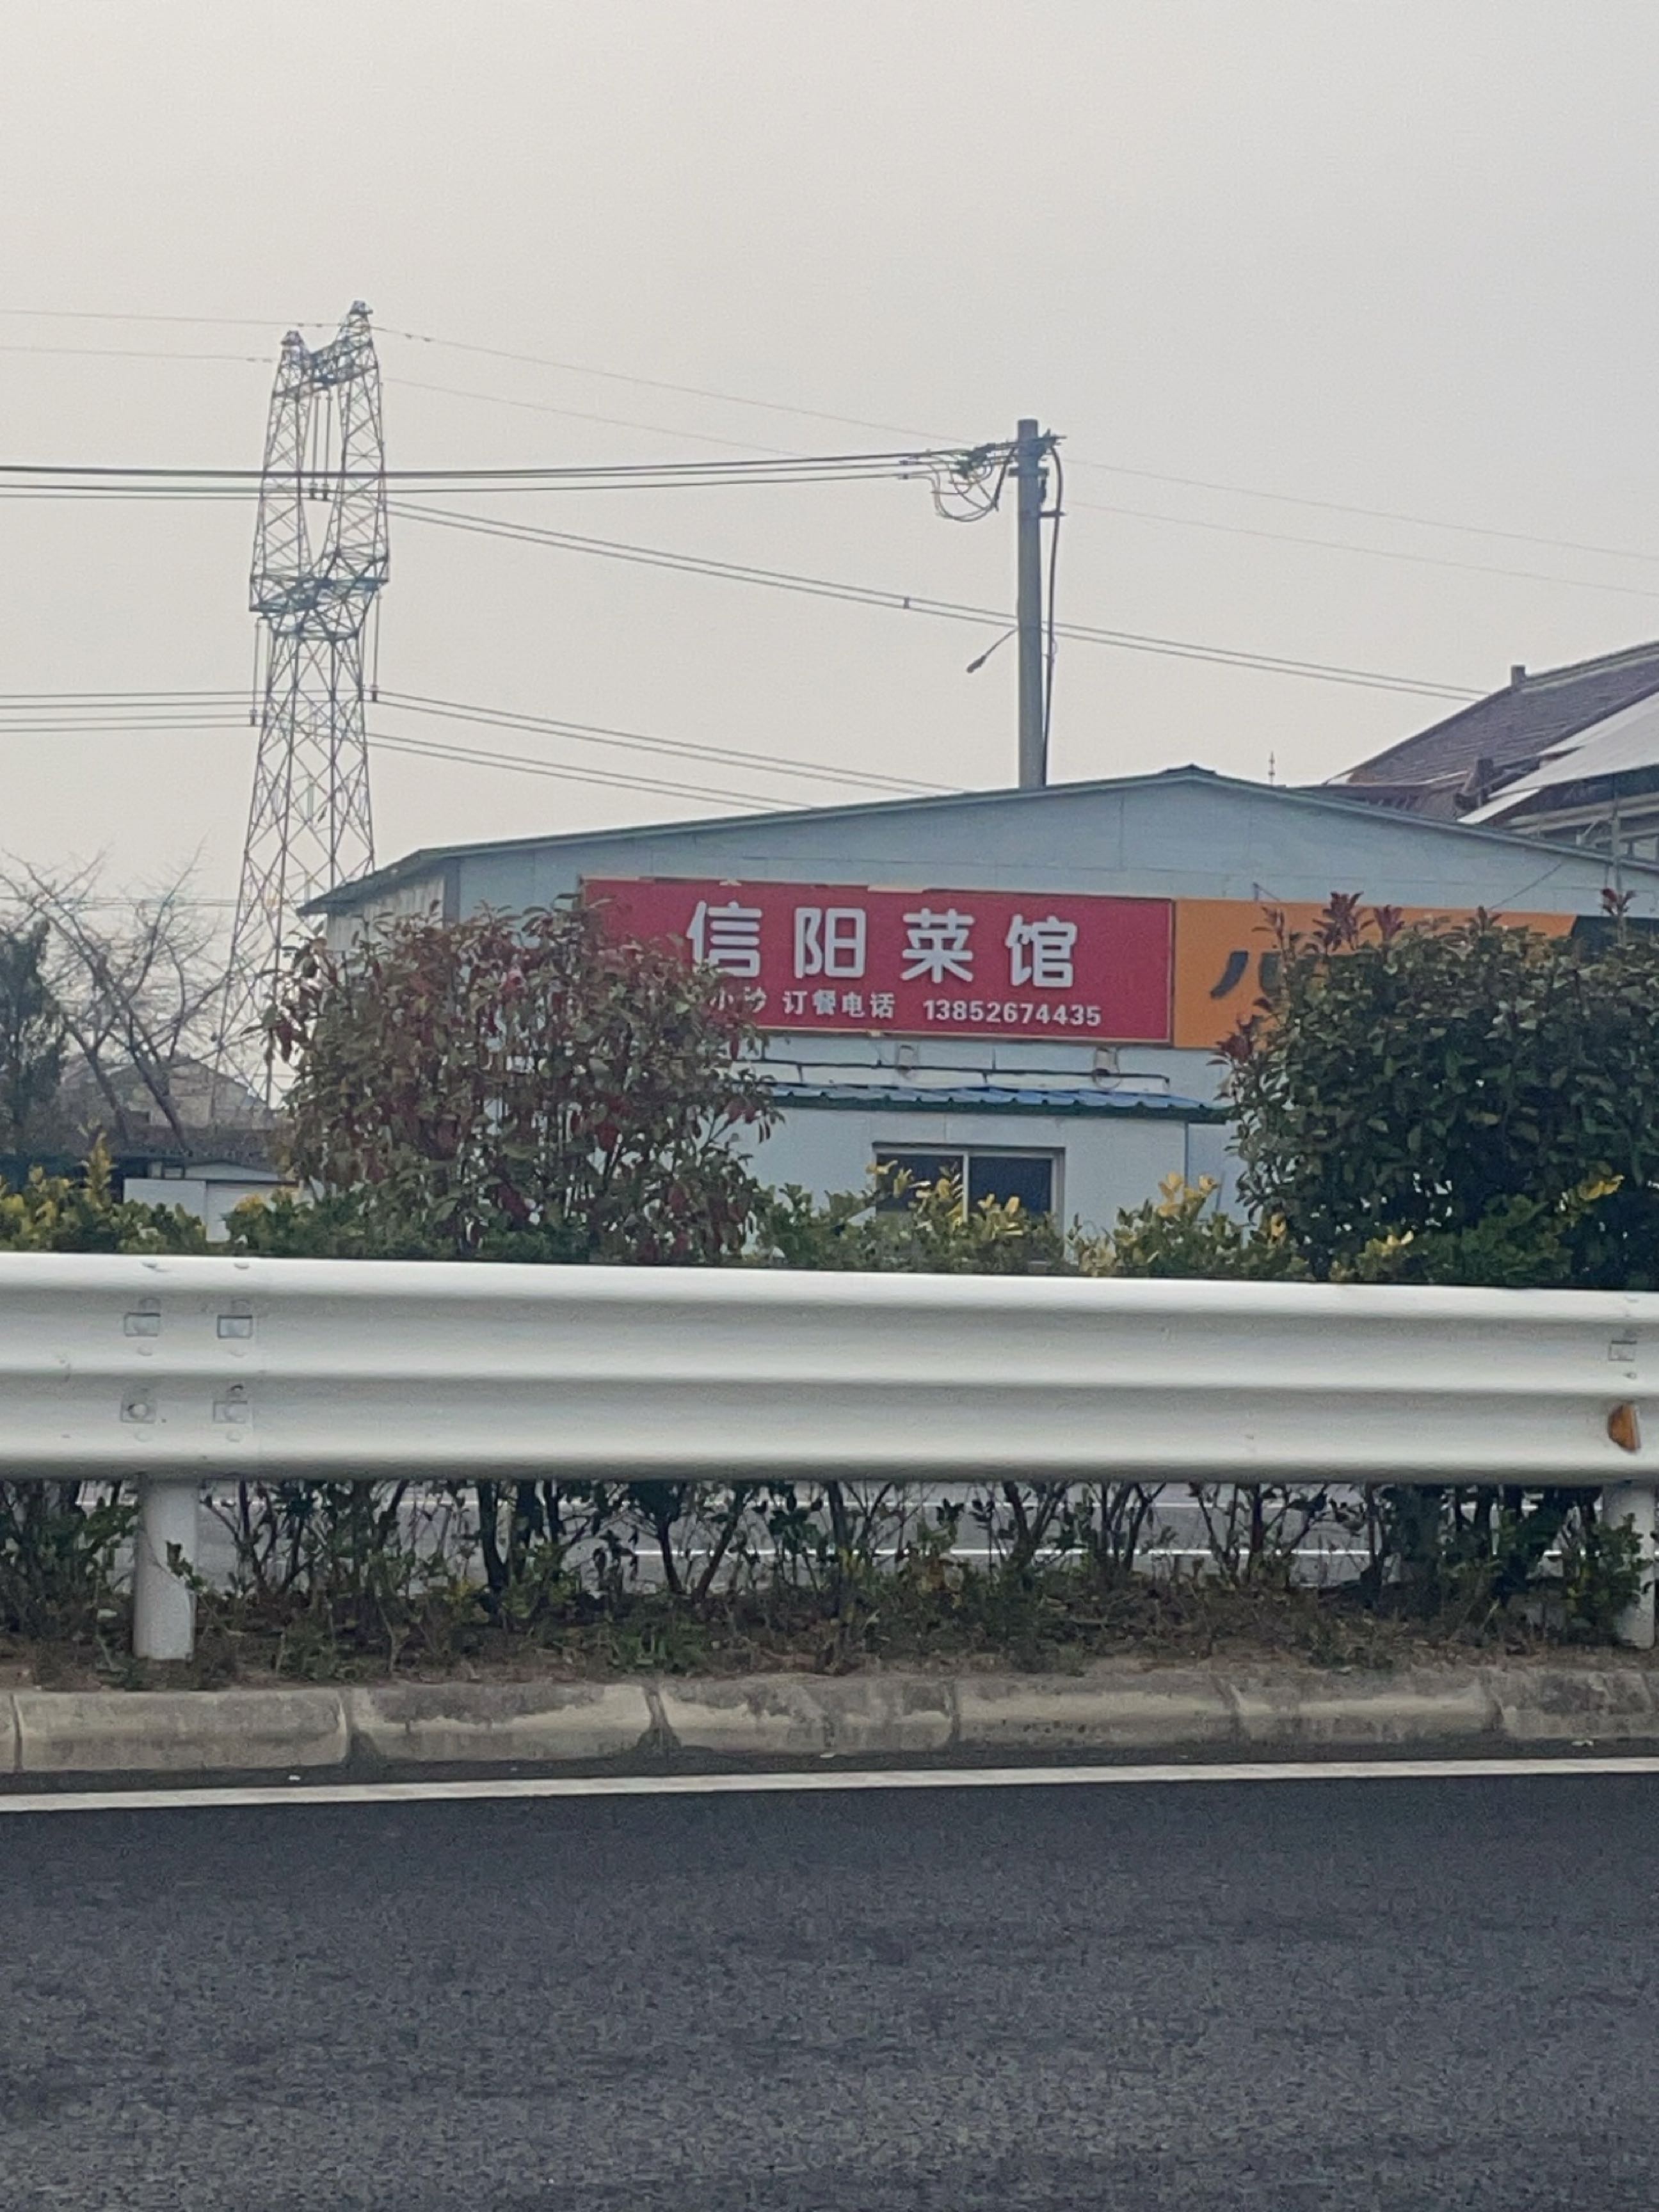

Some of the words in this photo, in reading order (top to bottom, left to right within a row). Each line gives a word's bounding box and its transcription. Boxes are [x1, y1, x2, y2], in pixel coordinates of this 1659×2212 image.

[687, 901, 1077, 987] 信阳菜馆
[782, 990, 895, 1019] 订餐电话
[923, 999, 1102, 1027] 13852674435
